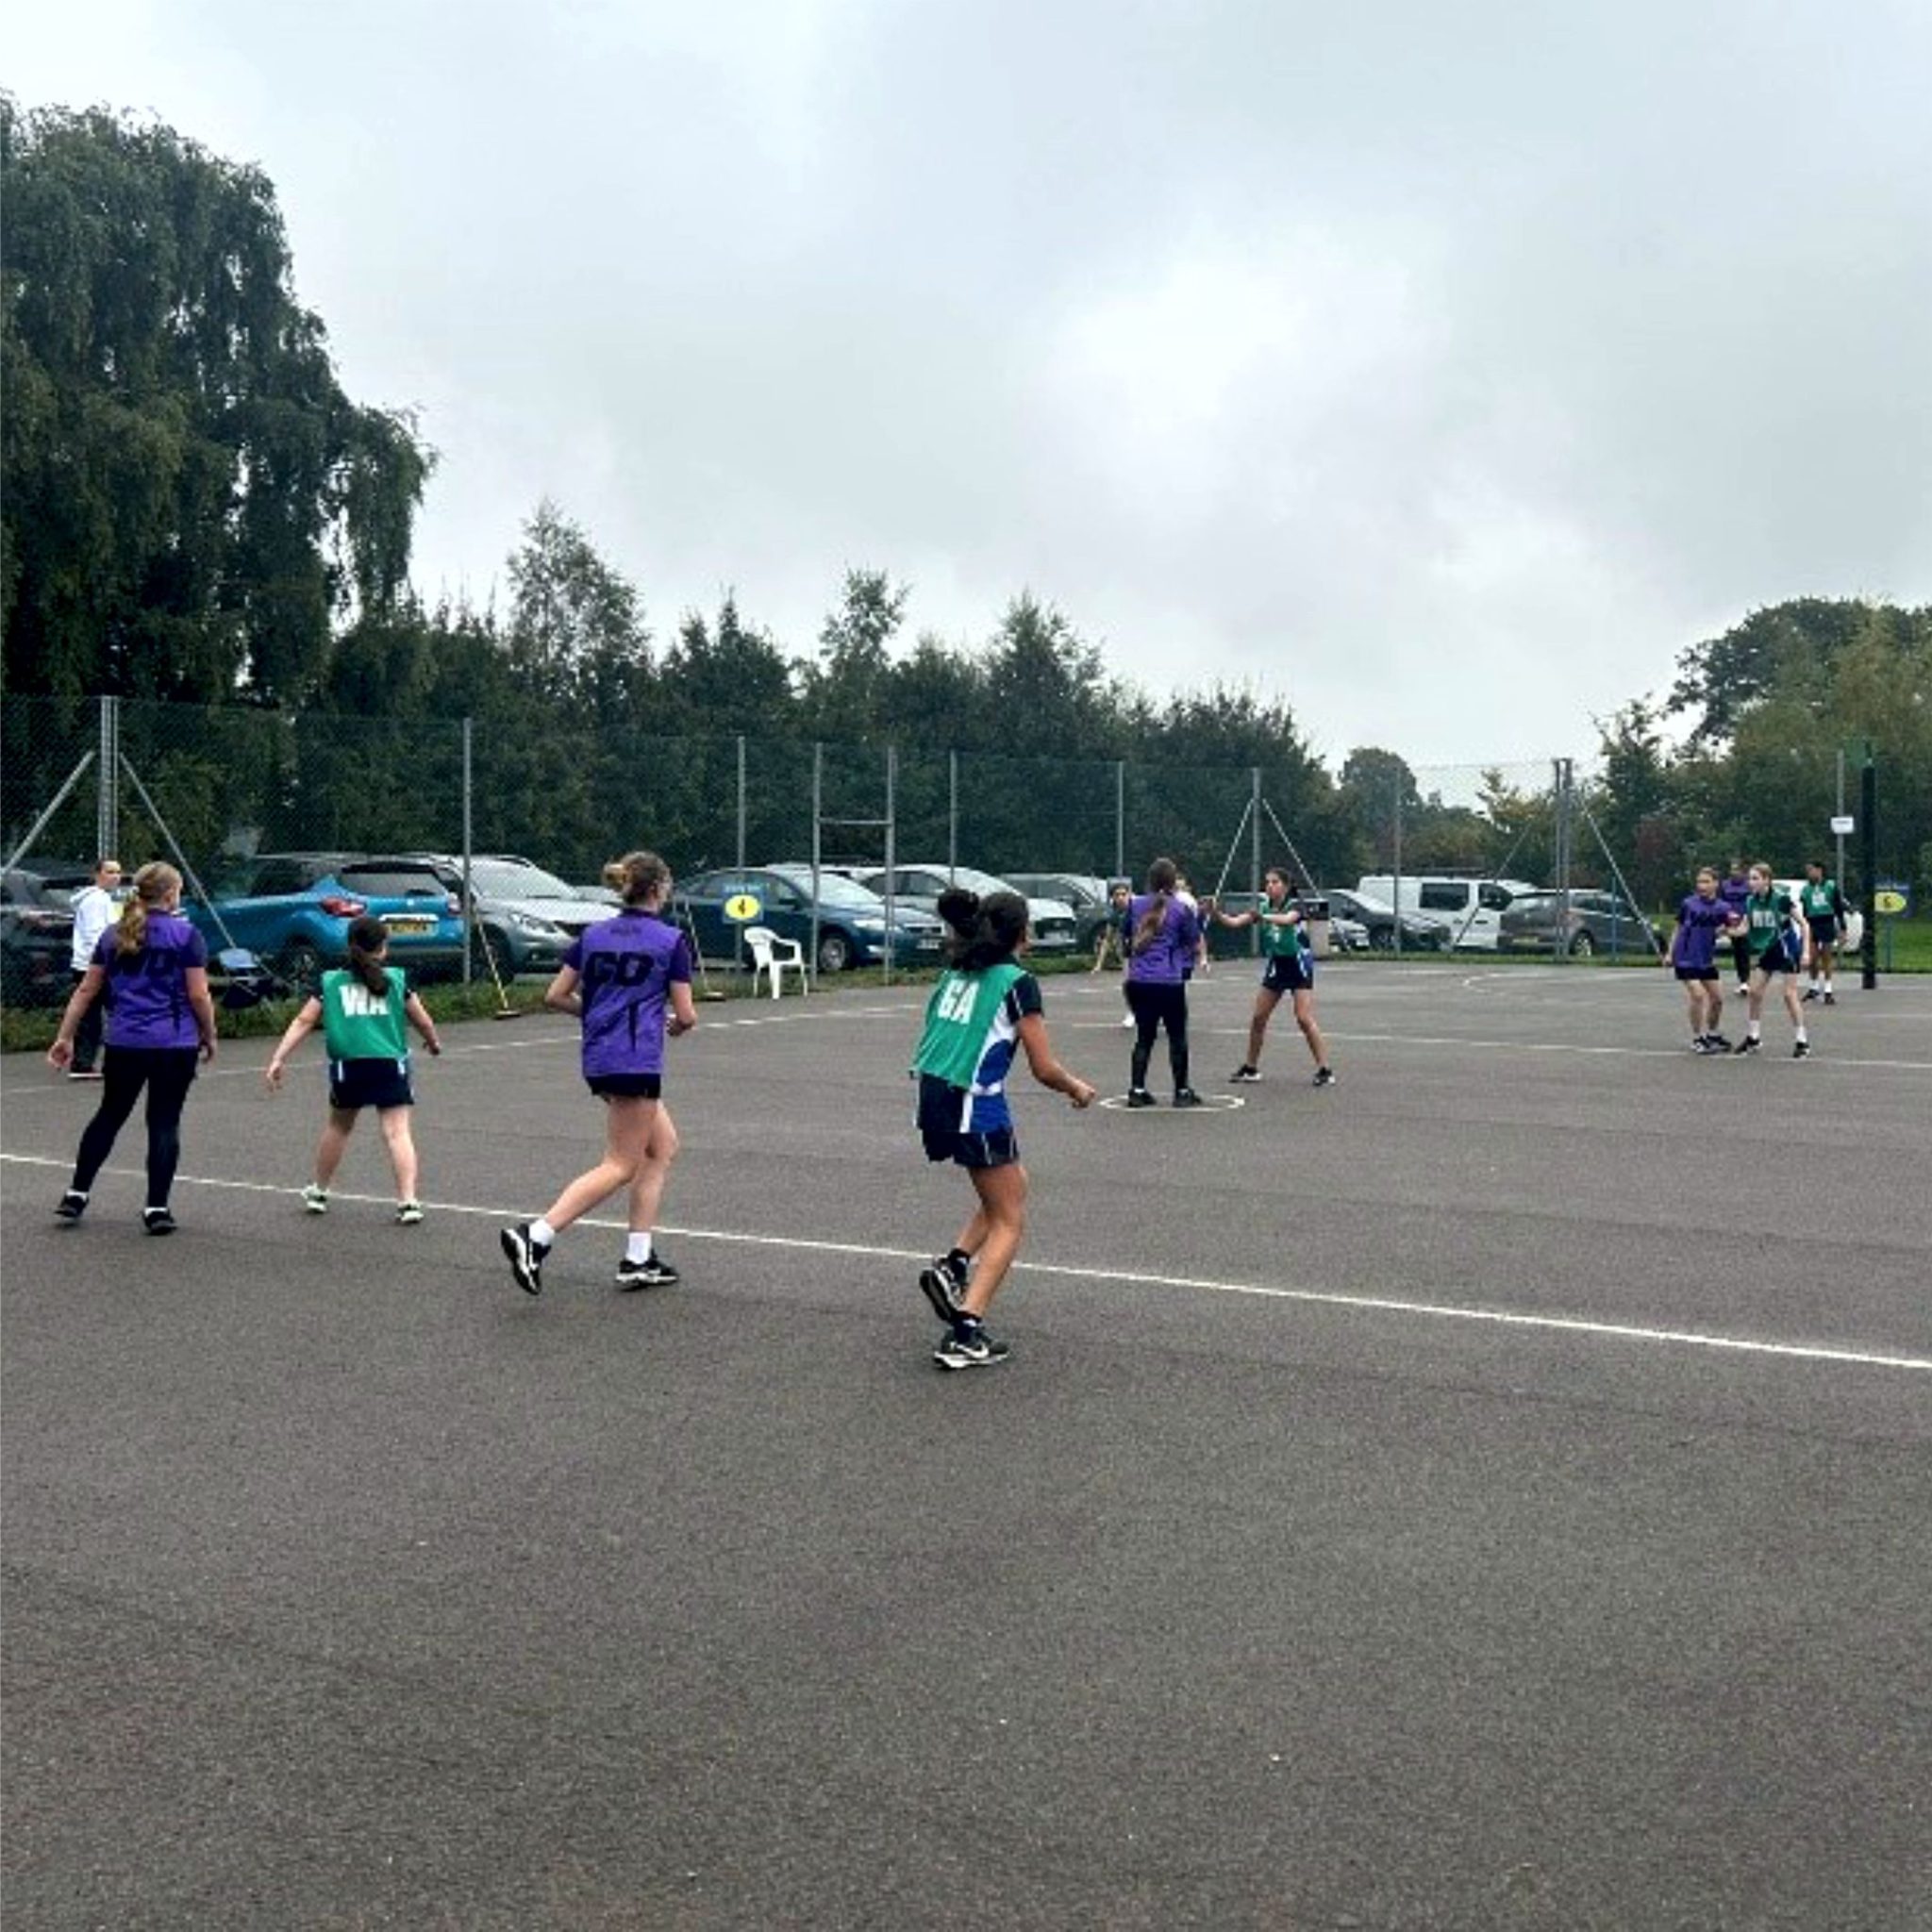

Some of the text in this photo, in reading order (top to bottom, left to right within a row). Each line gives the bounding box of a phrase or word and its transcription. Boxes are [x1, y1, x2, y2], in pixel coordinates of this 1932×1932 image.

[738, 898, 746, 915] 4
[584, 951, 655, 987] GD
[339, 985, 391, 1017] WA
[937, 978, 979, 1024] GA
